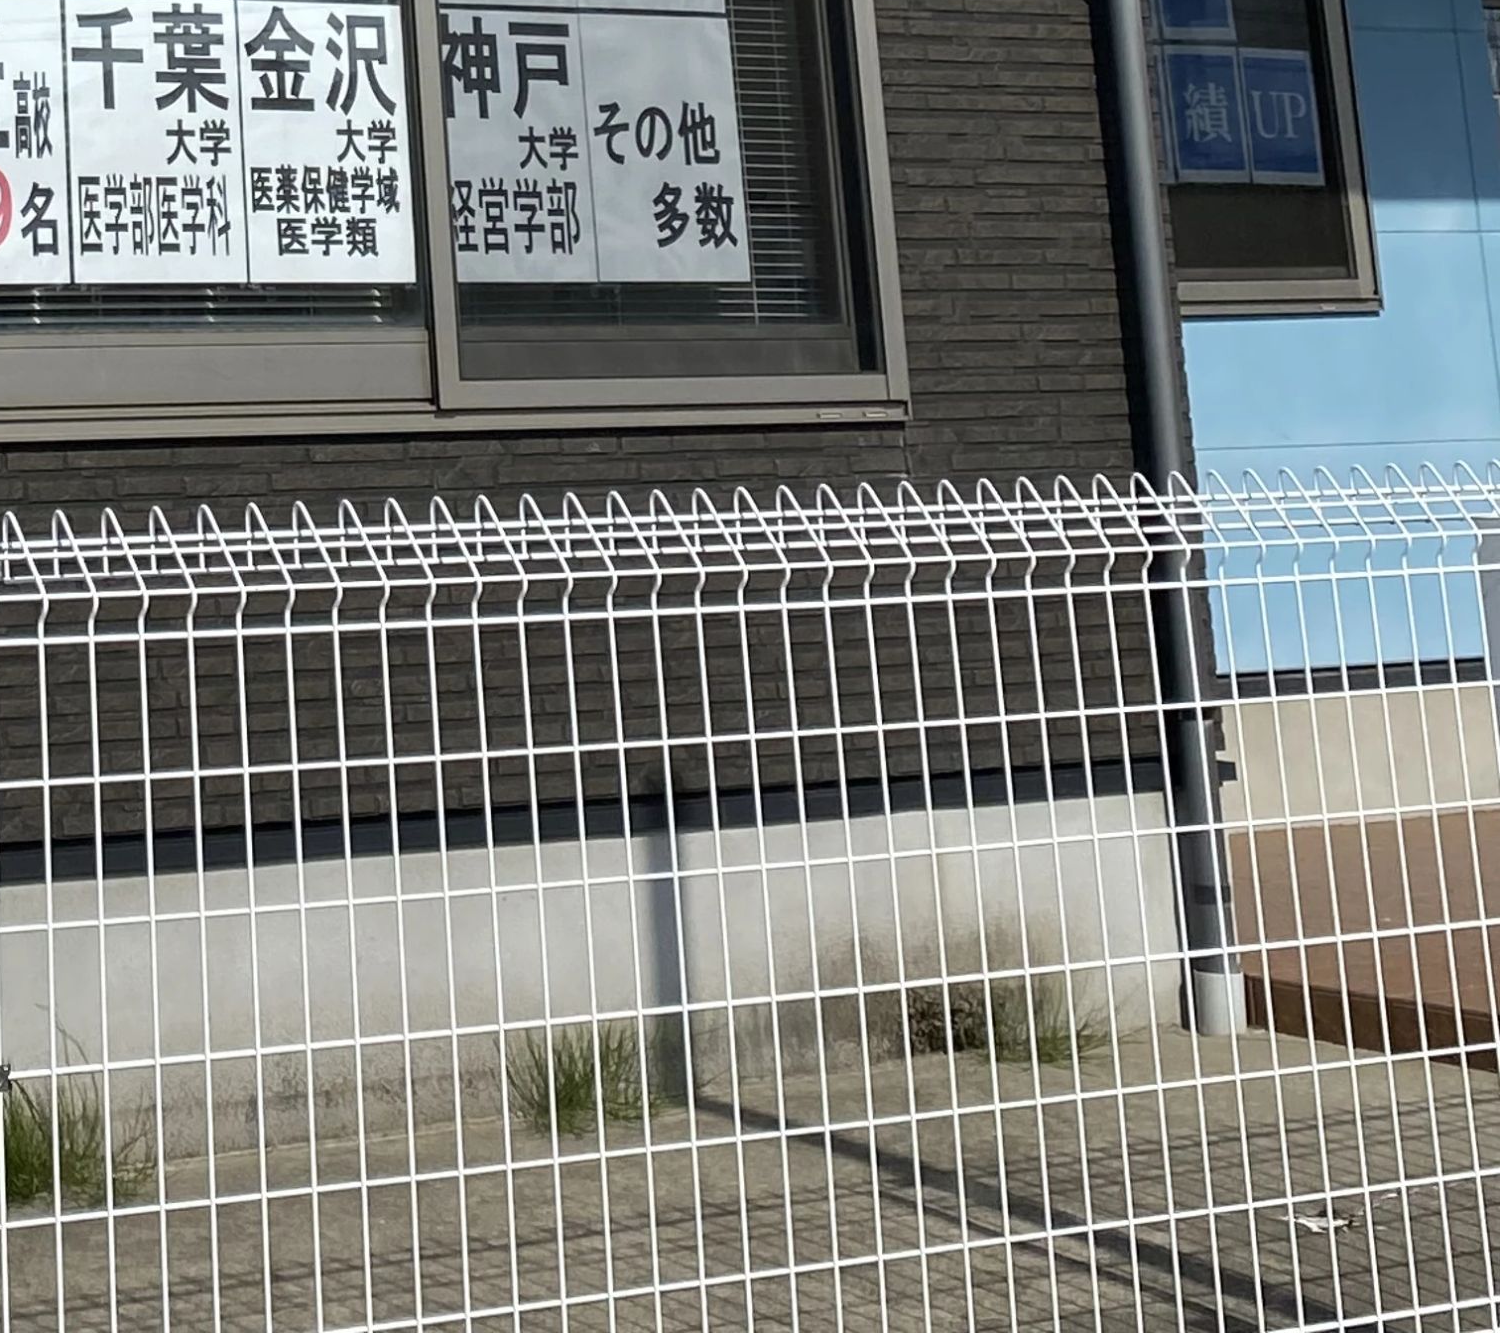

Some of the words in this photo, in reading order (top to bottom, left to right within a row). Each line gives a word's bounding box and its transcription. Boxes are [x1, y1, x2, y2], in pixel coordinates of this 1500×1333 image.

[71, 3, 230, 113] 千葉
[244, 6, 397, 116] 金沢
[440, 13, 570, 119] 神戸
[166, 119, 232, 166] 大学
[336, 119, 398, 164] 大学
[518, 126, 579, 171] 大学
[593, 102, 720, 166] その他
[78, 174, 231, 257] 医学部医学科
[250, 164, 401, 214] 医薬保健学域
[653, 182, 737, 249] 多数
[277, 218, 379, 257] 医学類
